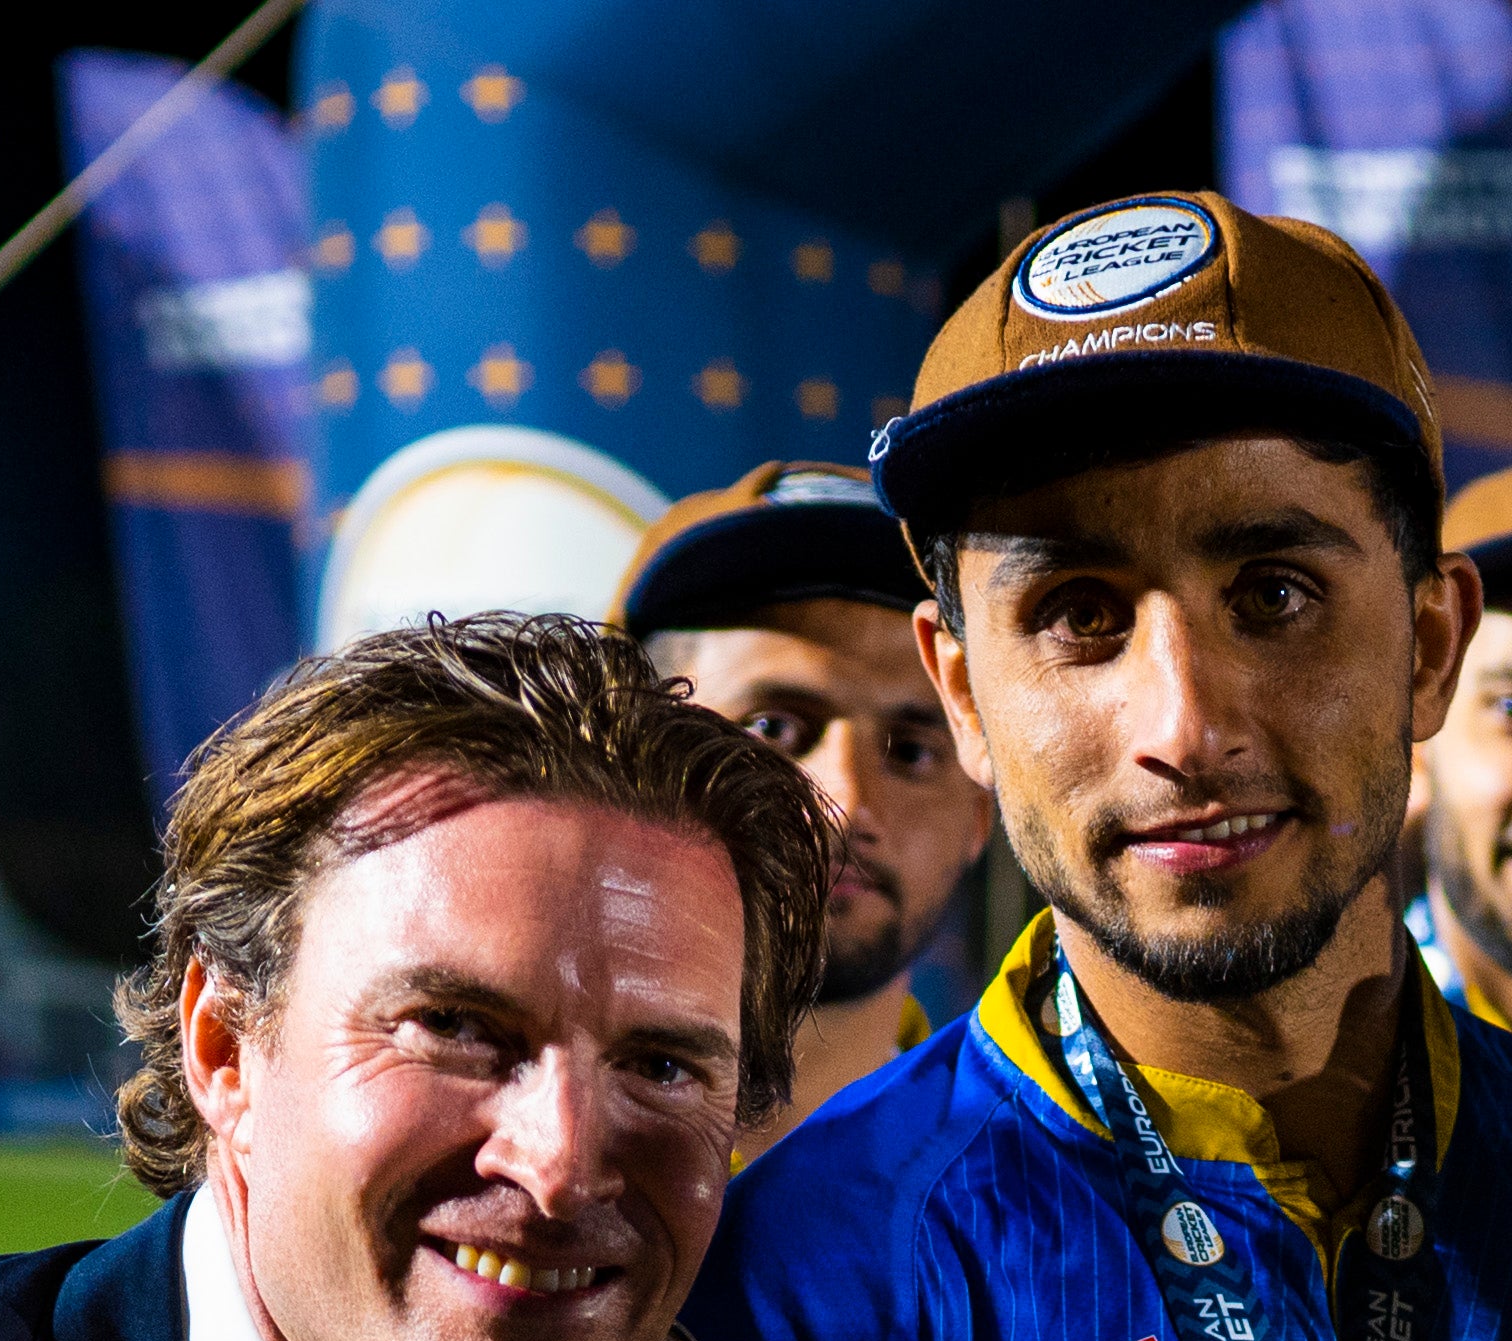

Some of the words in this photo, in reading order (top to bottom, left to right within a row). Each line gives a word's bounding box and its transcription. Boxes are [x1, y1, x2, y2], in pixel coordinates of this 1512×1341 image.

[1064, 250, 1185, 281] LEAGUE
[1019, 321, 1216, 371] CHAMPIONS
[1174, 1206, 1199, 1263] EUROPEAN
[1182, 1204, 1210, 1263] CRICKET
